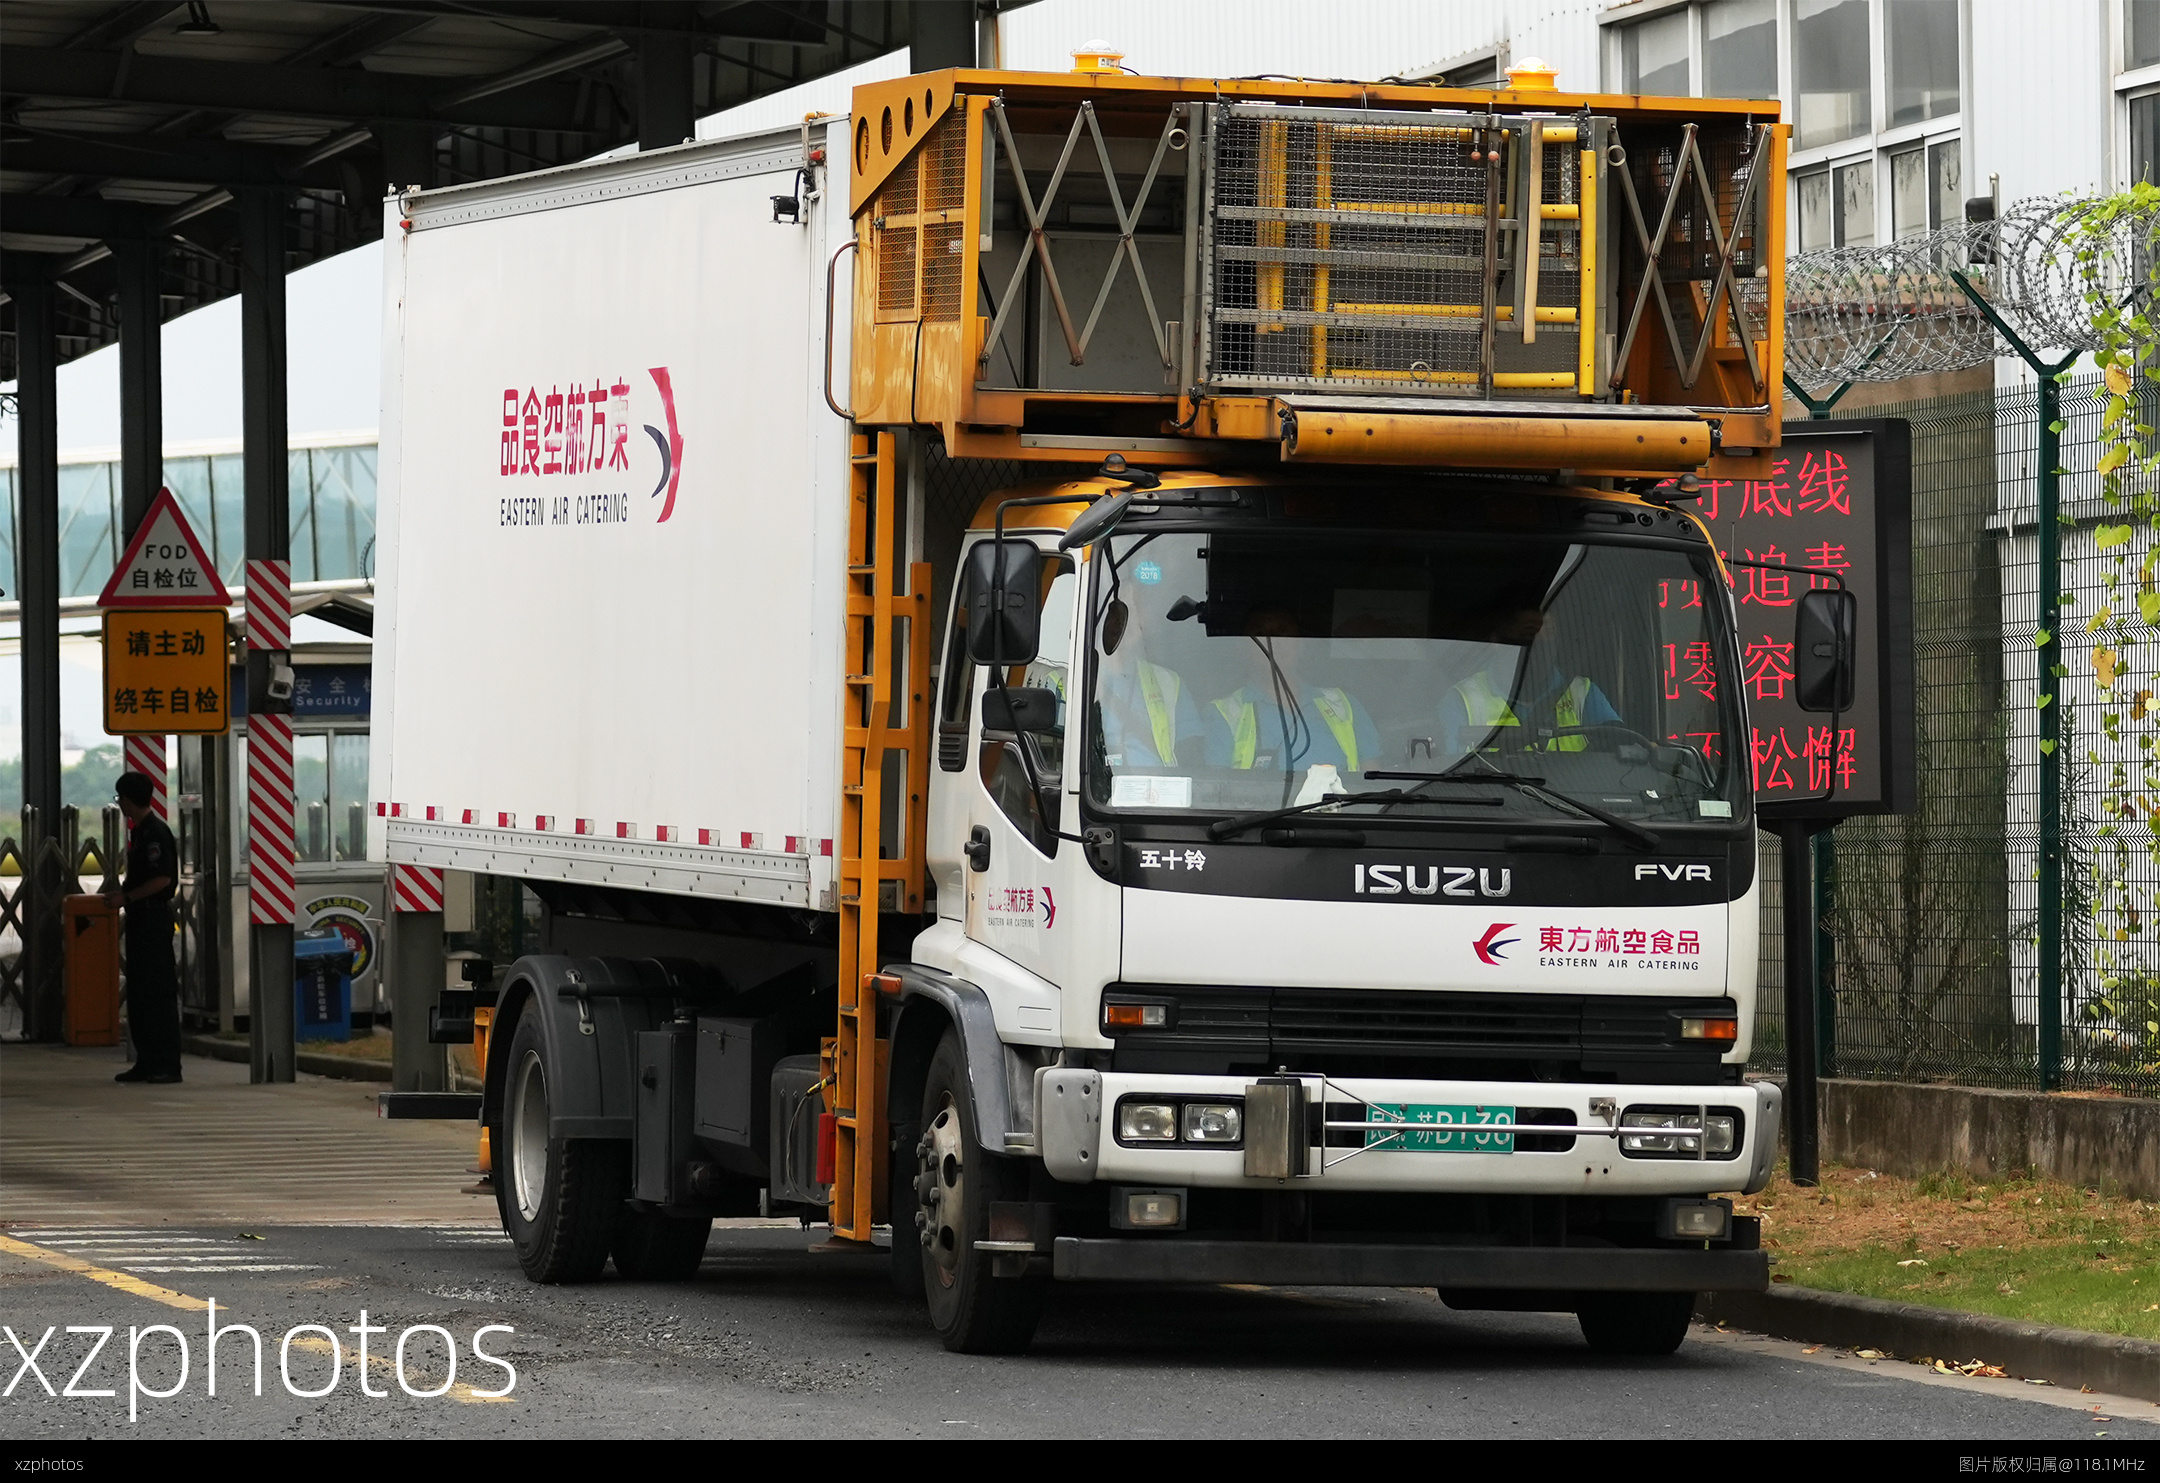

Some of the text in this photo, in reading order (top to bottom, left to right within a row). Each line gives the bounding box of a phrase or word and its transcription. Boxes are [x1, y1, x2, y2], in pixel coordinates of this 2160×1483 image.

[500, 492, 628, 526] EASTERN AIR CATERING
[145, 544, 187, 560] FOD
[132, 567, 198, 589] 自检位
[1140, 571, 1158, 580] 2018
[127, 629, 205, 657] 请主动
[114, 686, 219, 716] 绕车自检
[296, 695, 361, 707] Security
[1139, 849, 1207, 872] 五十铃
[1355, 864, 1511, 898] ISUZU
[1634, 862, 1713, 882] FVR
[1538, 926, 1700, 955] 東方航空食品
[1540, 957, 1699, 971] EASTERN AIR CATERING
